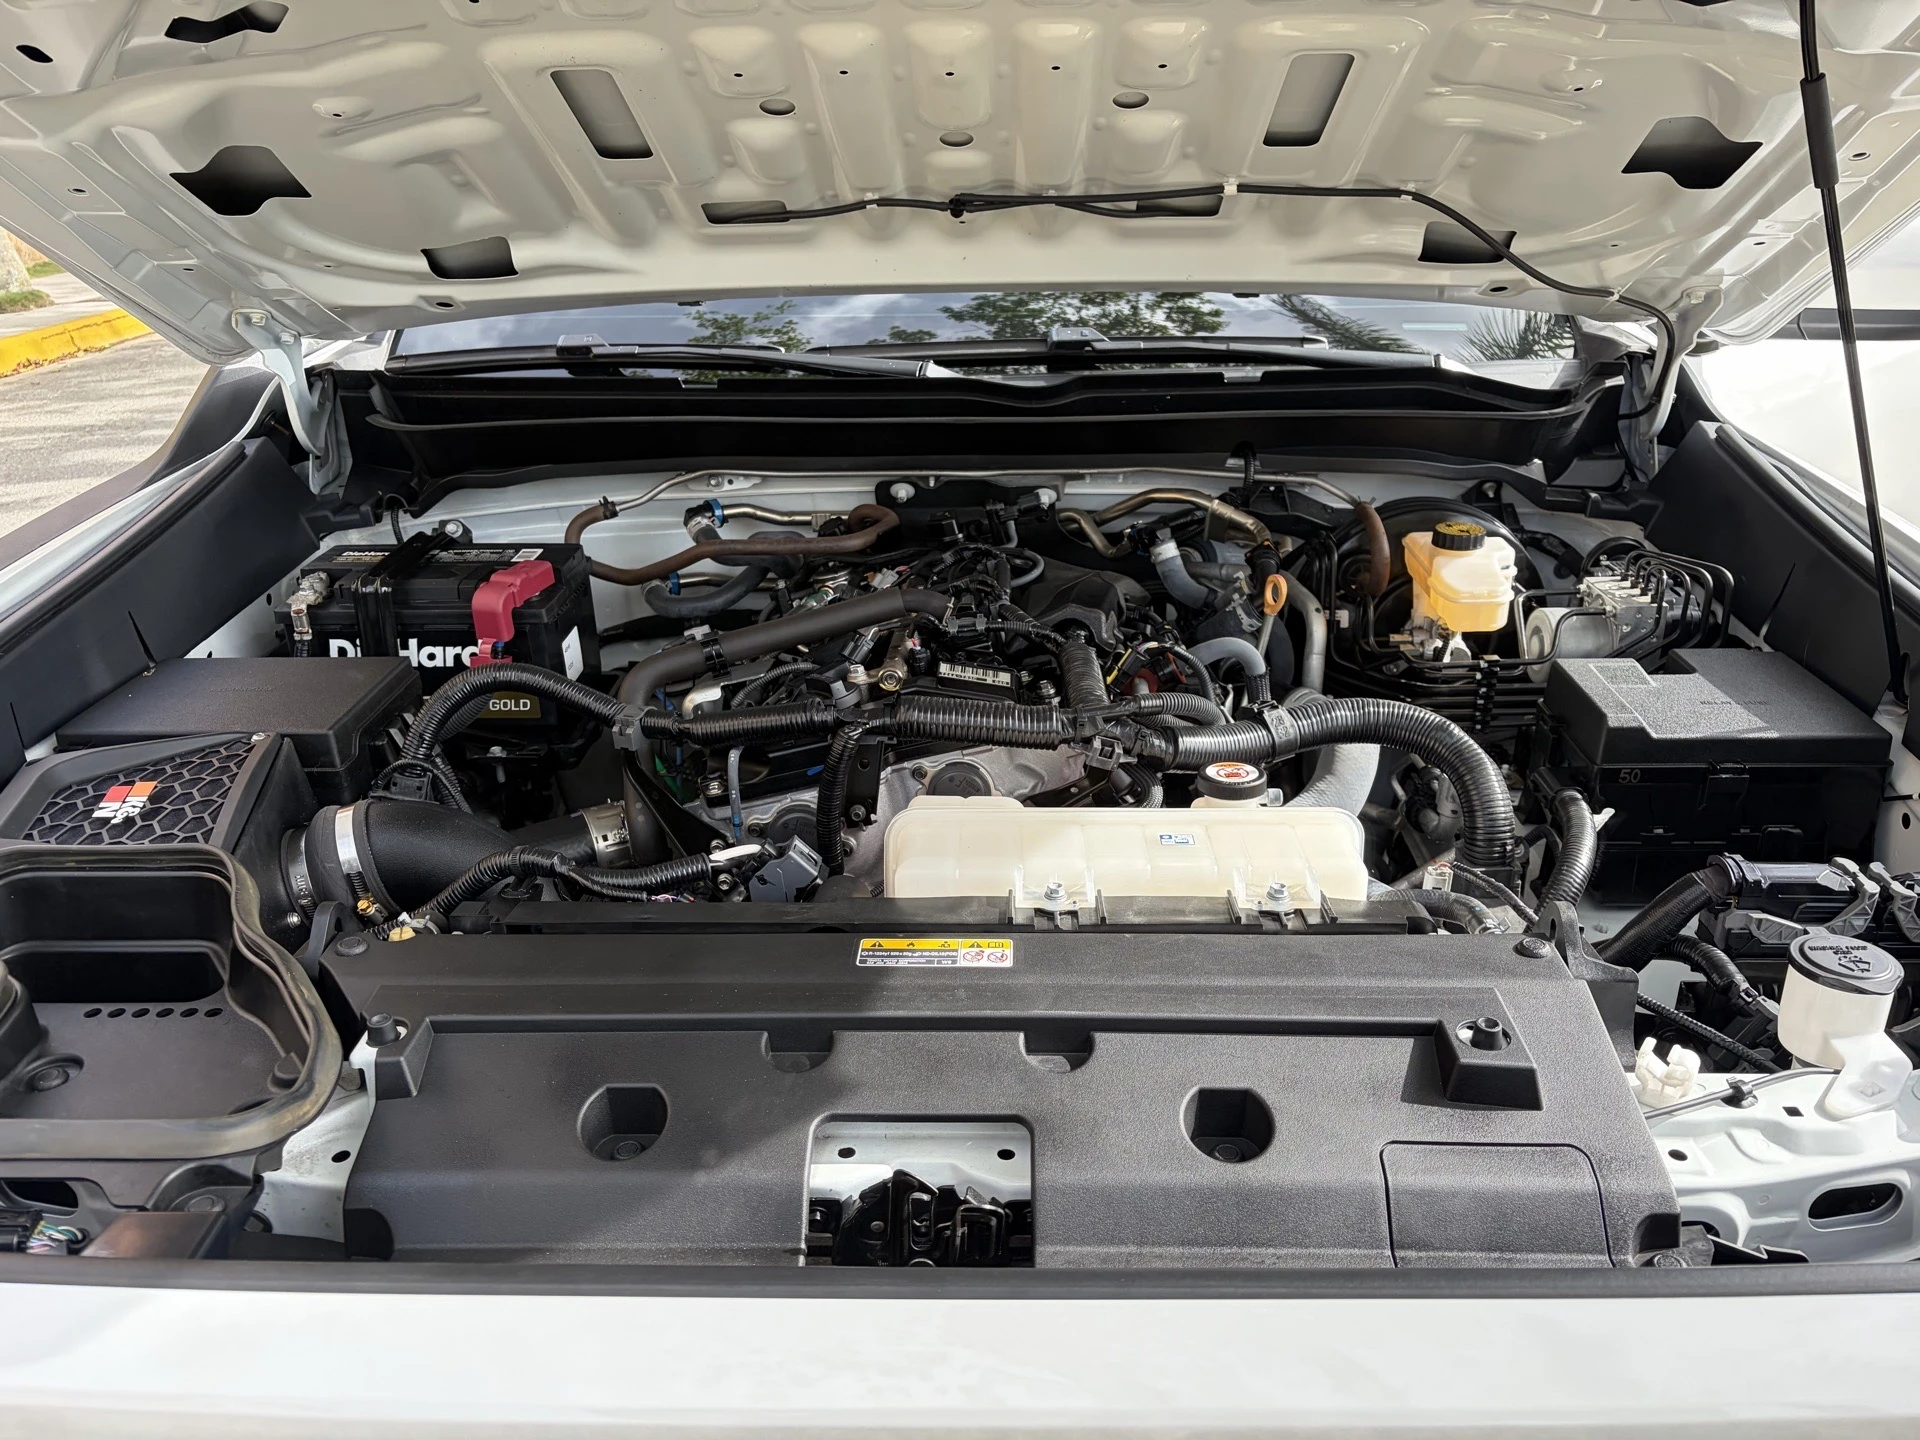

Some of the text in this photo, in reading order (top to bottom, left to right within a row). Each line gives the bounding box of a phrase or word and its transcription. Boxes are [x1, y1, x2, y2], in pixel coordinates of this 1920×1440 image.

[329, 638, 483, 668] DiHar
[489, 699, 531, 712] GOLD
[1618, 768, 1642, 784] 50
[91, 796, 148, 824] K&N
